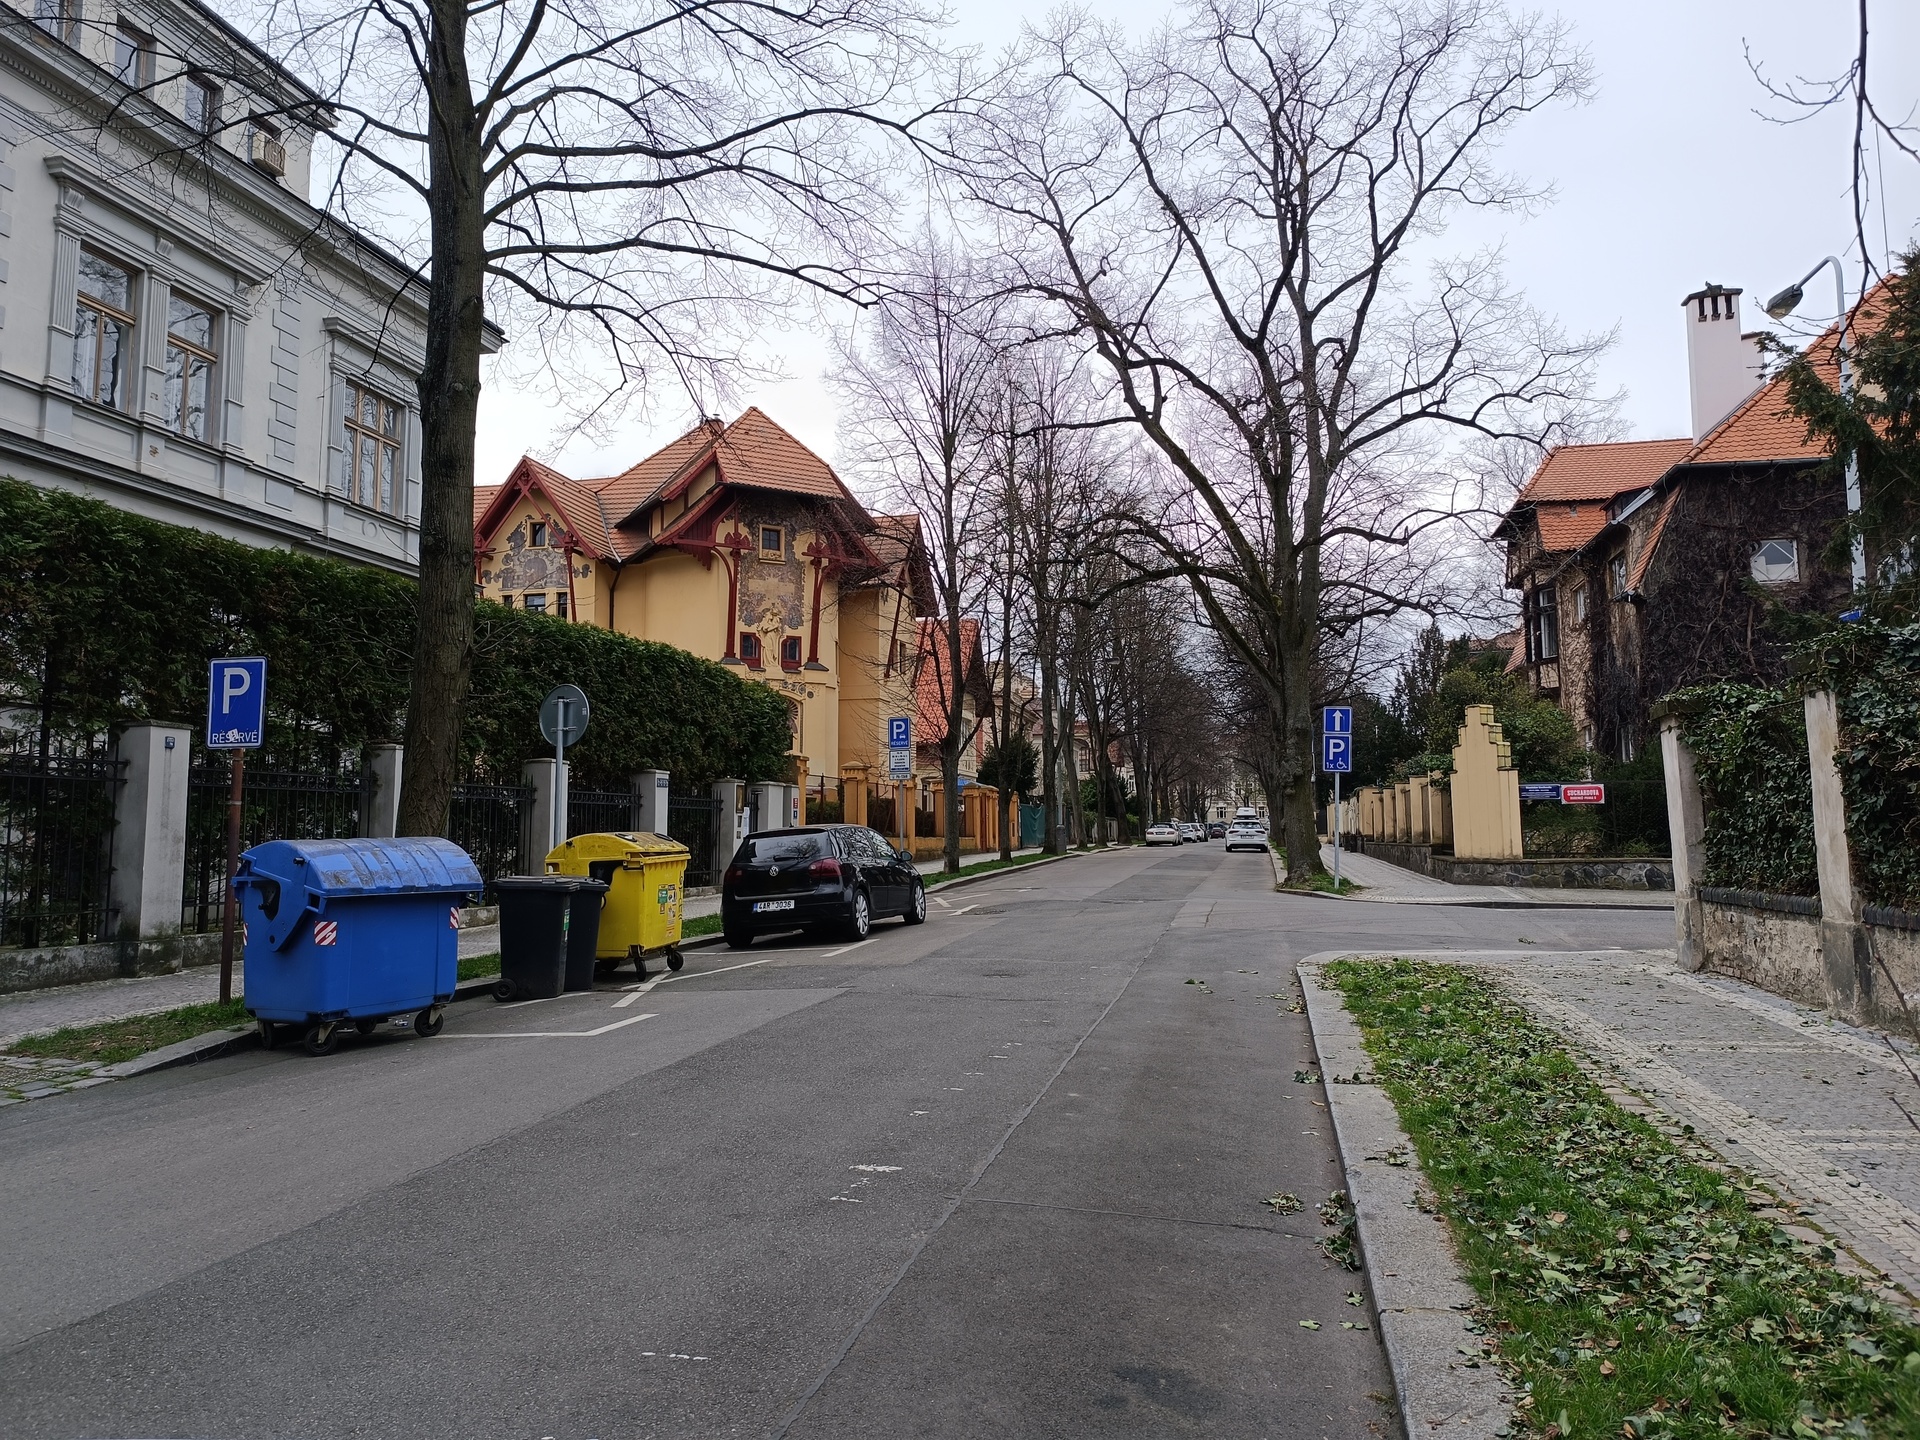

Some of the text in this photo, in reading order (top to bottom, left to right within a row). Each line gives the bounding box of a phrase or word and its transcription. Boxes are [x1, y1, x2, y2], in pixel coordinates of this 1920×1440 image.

[223, 668, 250, 714] P
[893, 721, 905, 739] P
[1329, 739, 1345, 760] P
